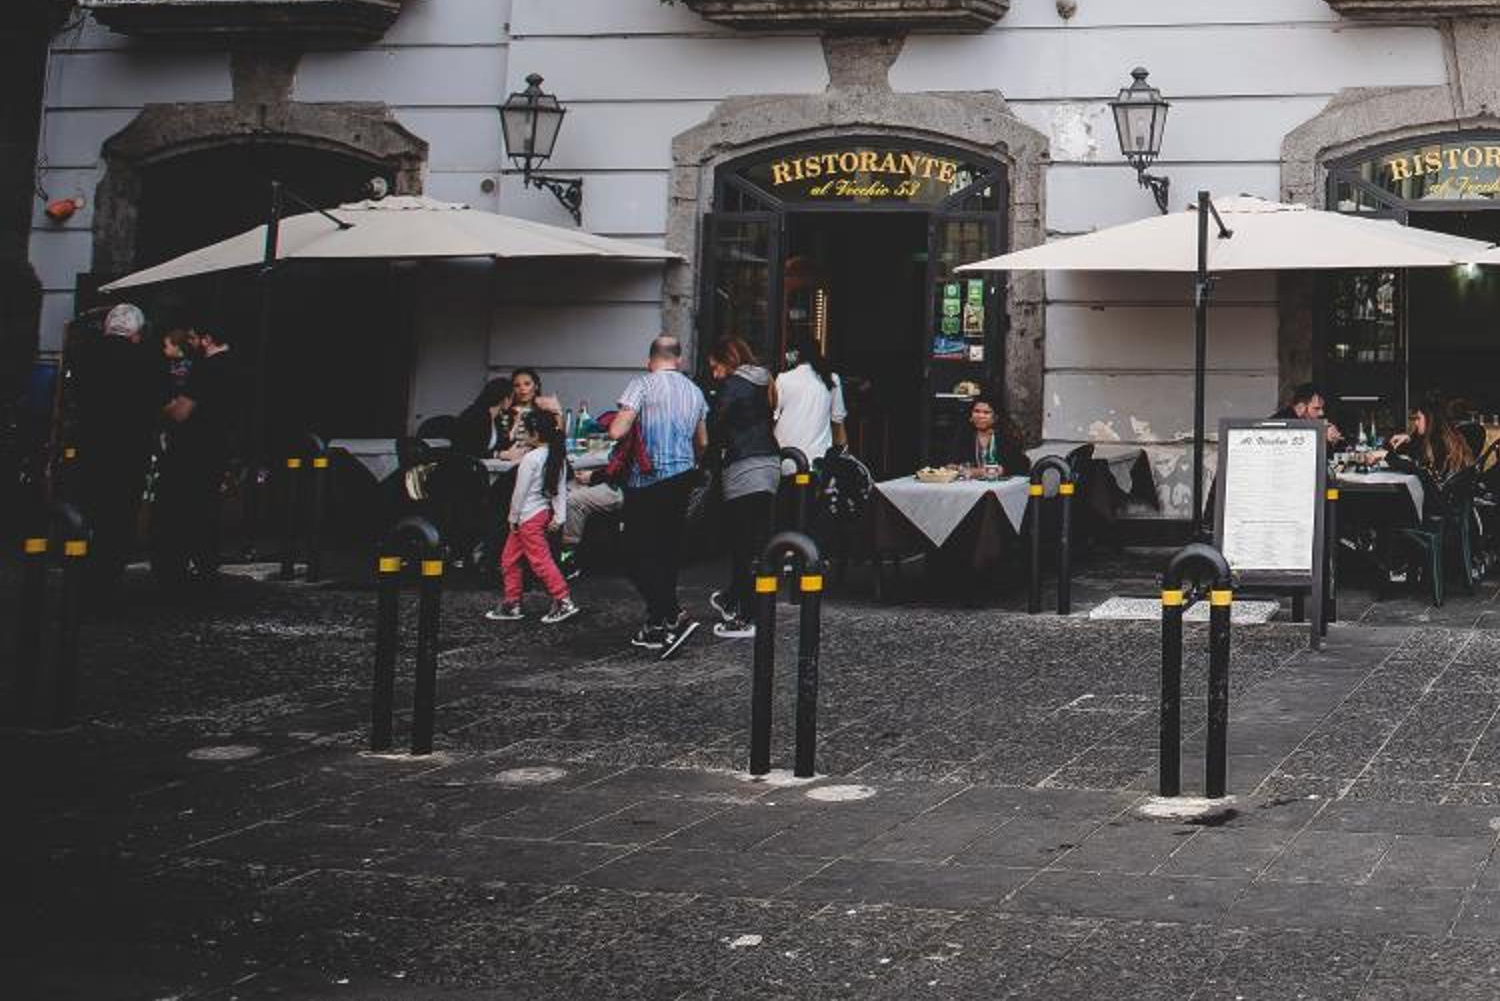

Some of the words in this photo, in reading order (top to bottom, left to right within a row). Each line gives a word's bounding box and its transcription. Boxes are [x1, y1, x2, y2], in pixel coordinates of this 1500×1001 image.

[771, 151, 958, 185] RISTORANTE
[809, 180, 832, 196] al
[834, 180, 889, 197] Vecchio
[893, 181, 921, 197] 53
[1428, 178, 1450, 194] al
